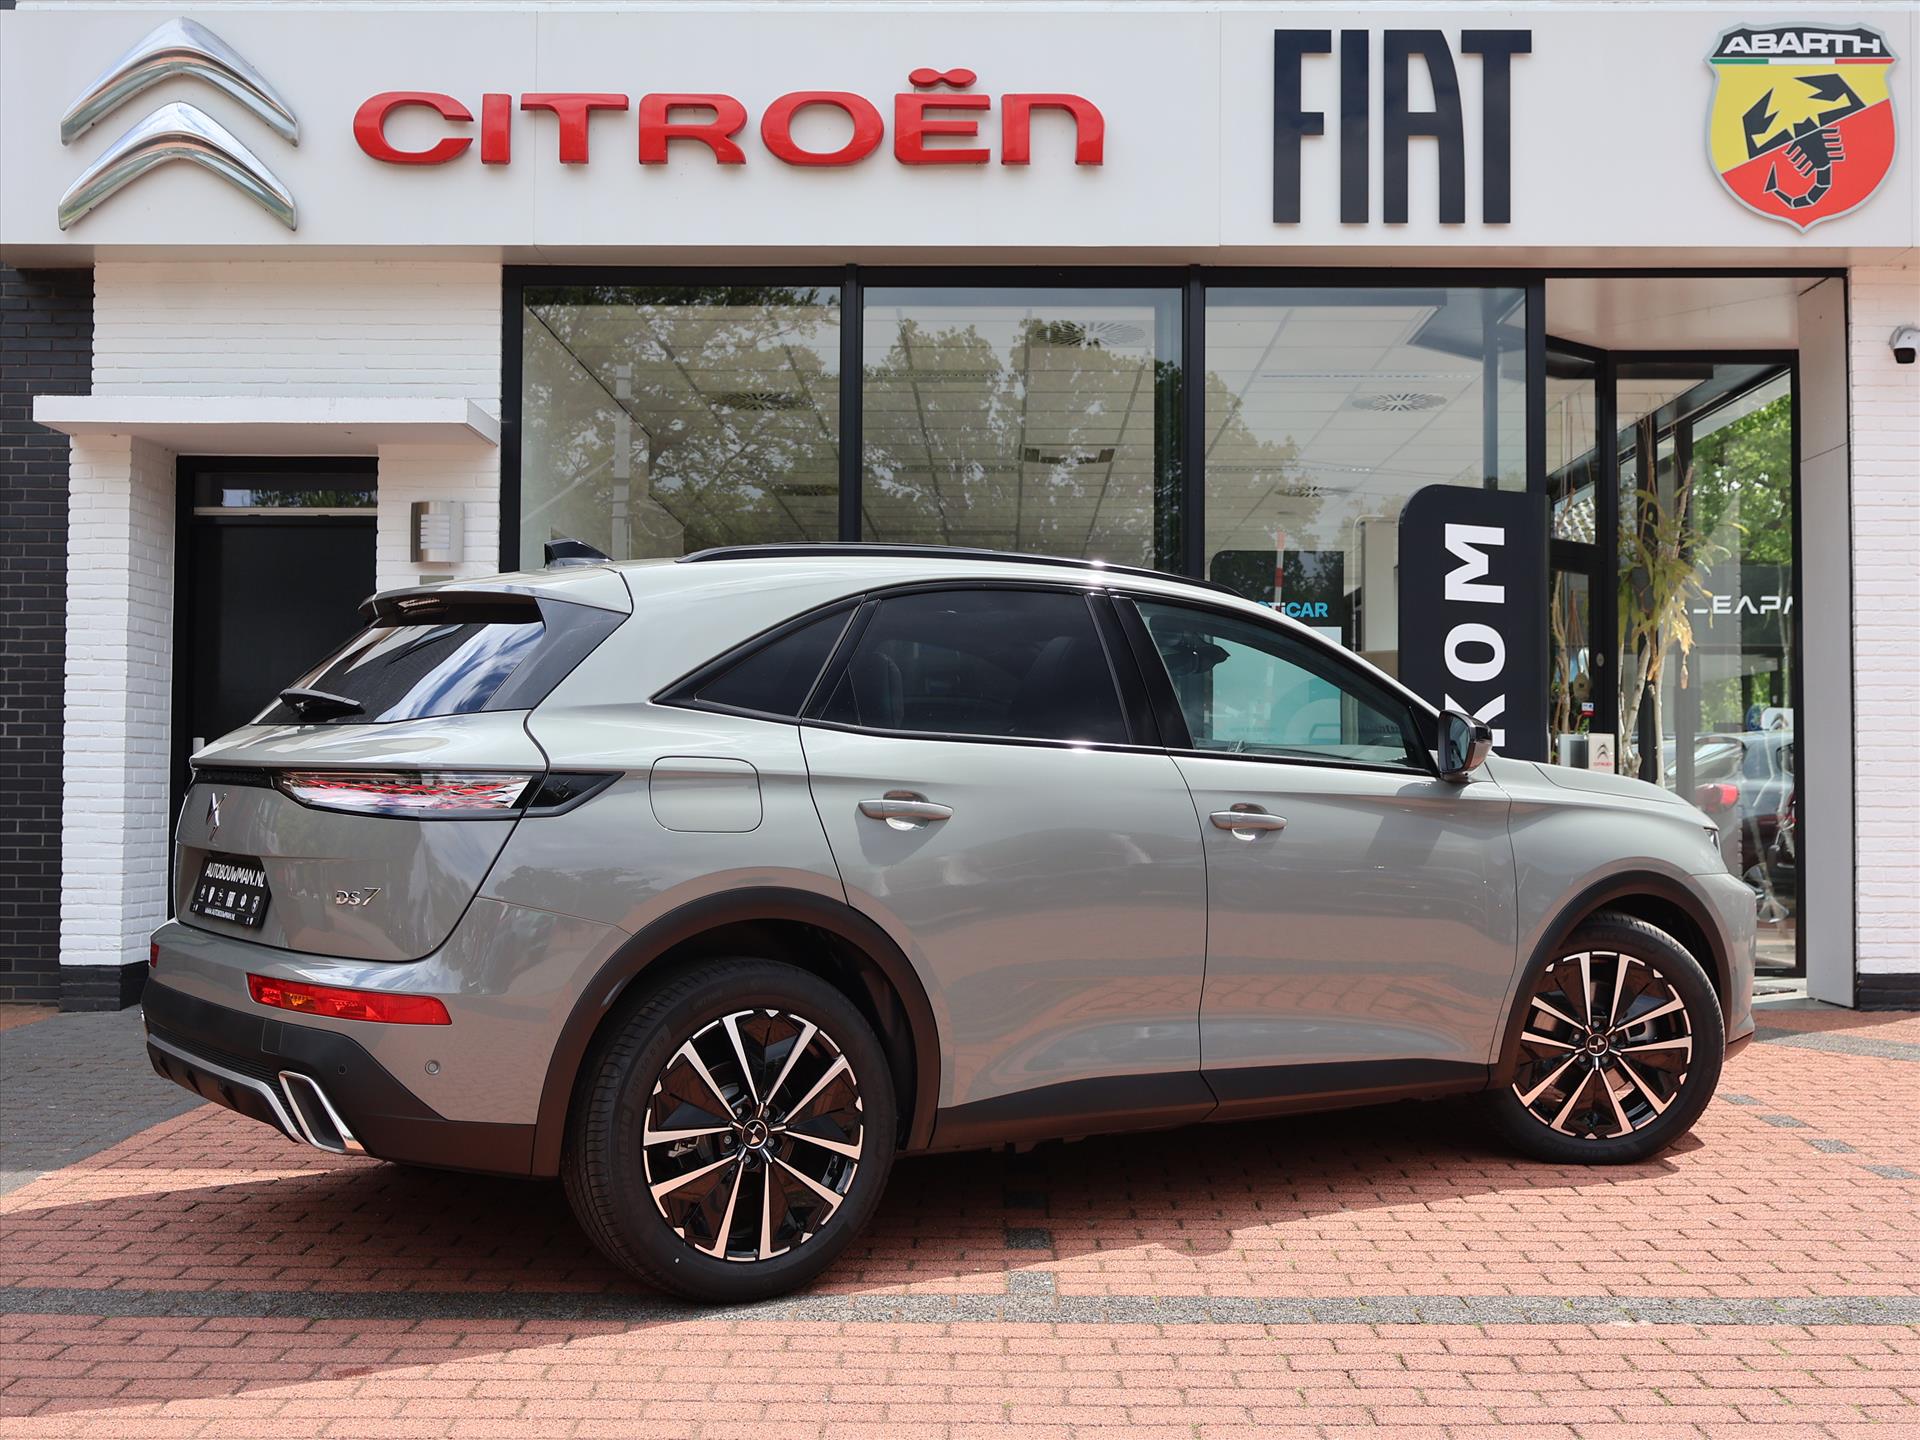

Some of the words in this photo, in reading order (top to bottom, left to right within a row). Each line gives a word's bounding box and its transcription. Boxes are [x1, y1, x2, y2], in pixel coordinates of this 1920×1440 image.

[1723, 32, 1881, 54] ABARTH
[353, 68, 1105, 166] CITROËN
[1273, 29, 1532, 224] FIAT
[205, 862, 265, 887] AUTOBOUWMAN.NL
